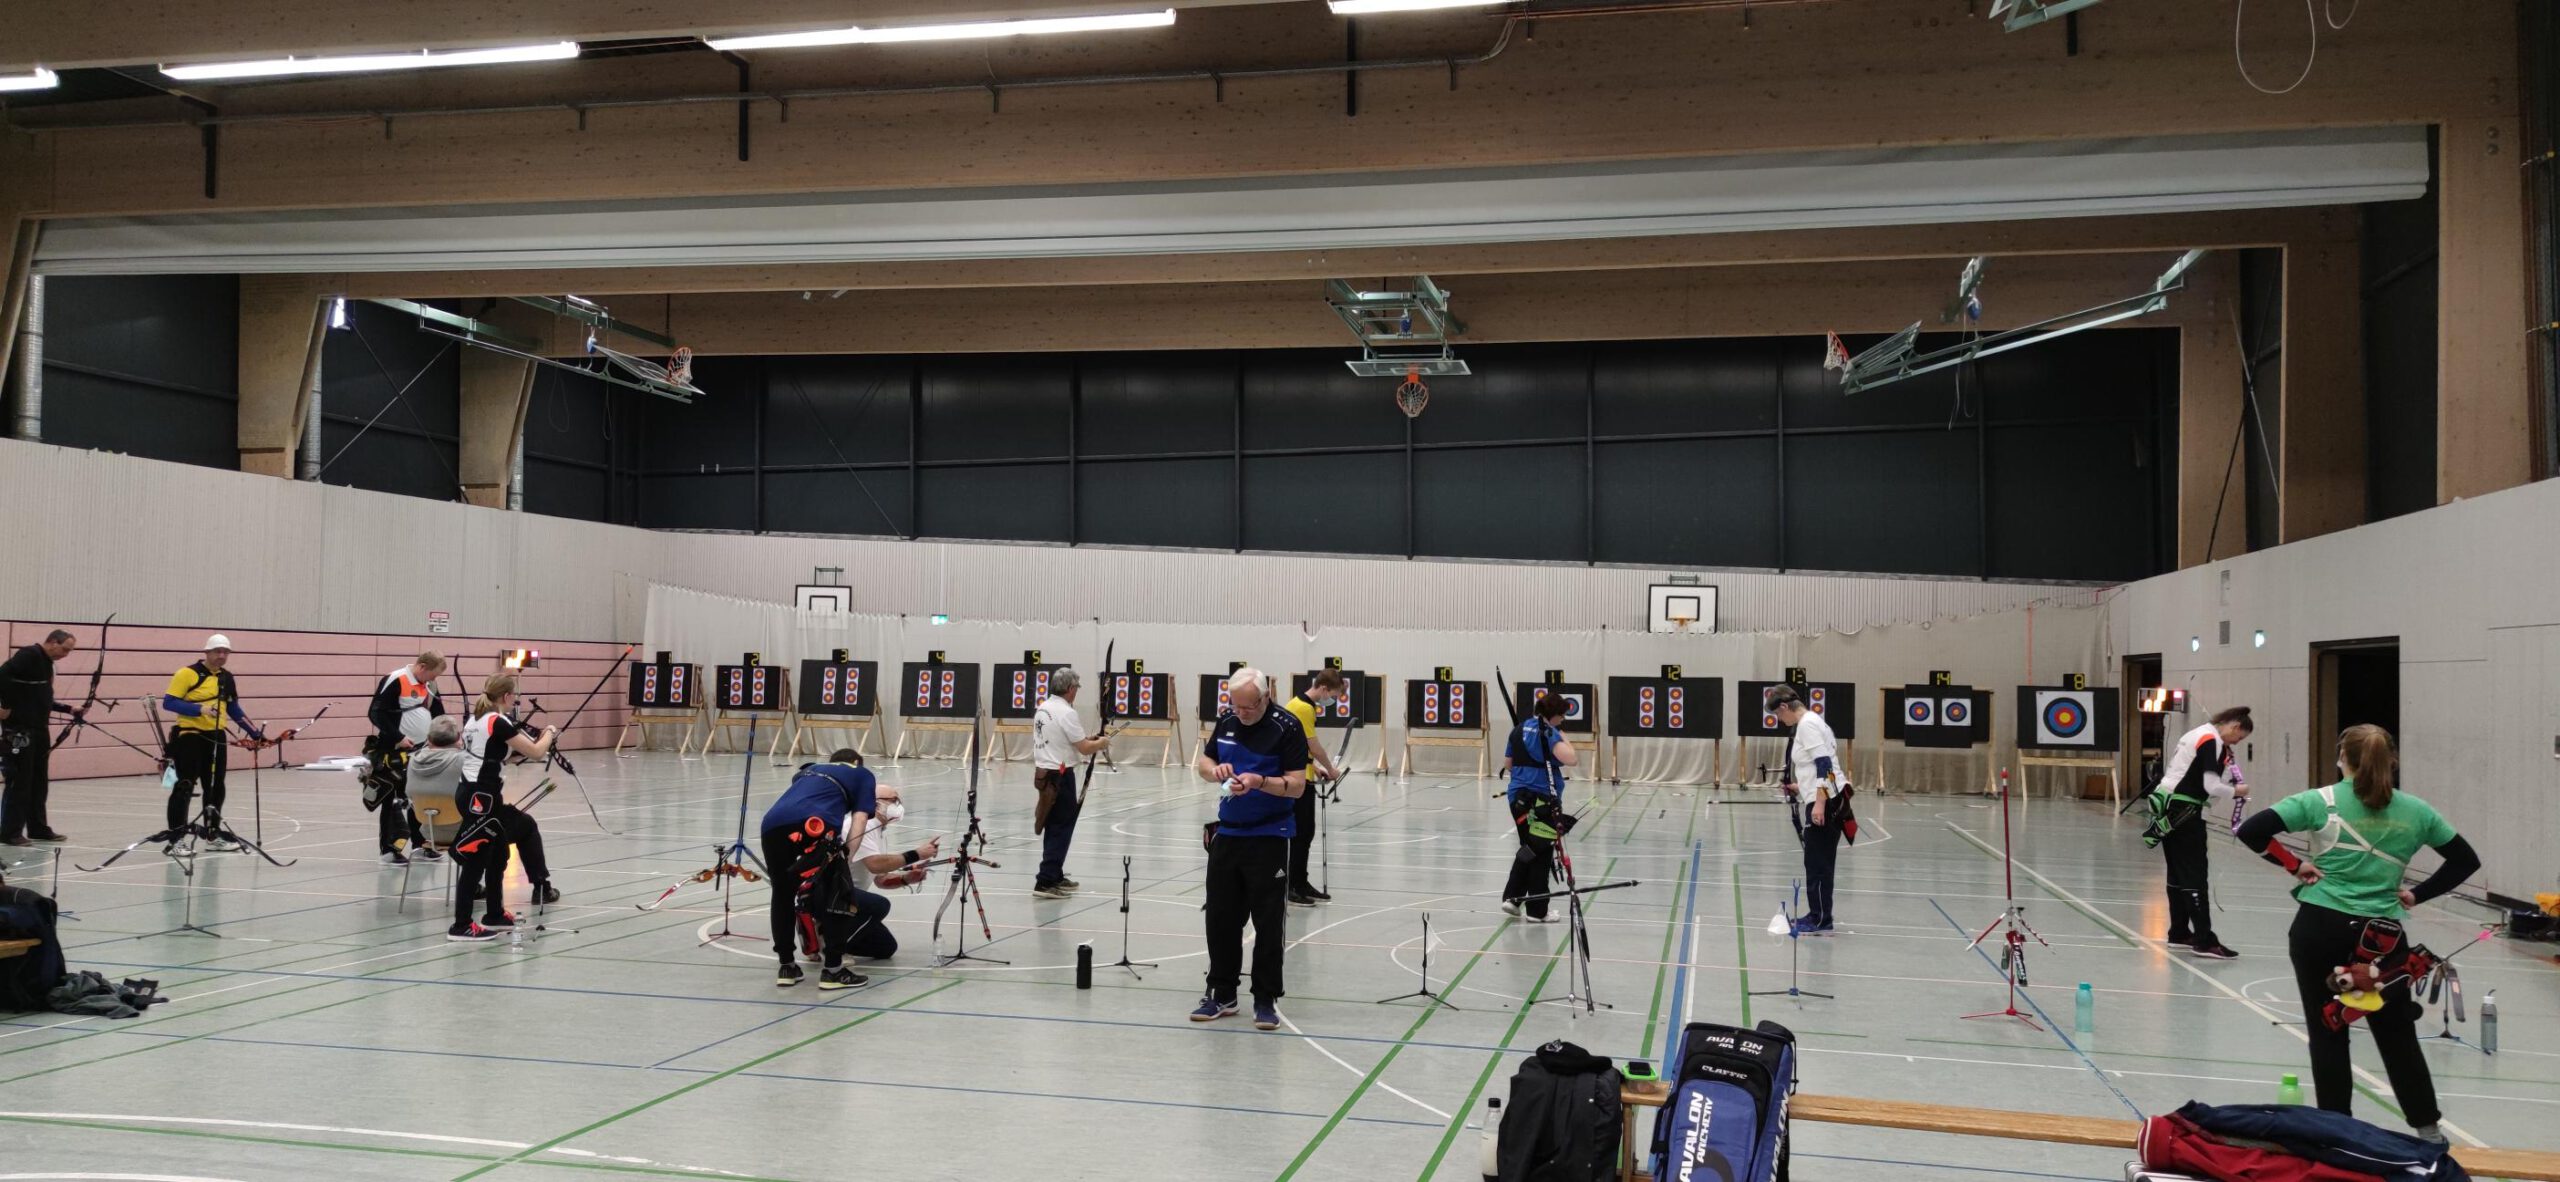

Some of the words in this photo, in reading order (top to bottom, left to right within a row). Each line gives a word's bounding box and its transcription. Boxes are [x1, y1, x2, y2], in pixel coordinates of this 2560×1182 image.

[750, 652, 760, 667] 2
[840, 648, 849, 663] 3
[935, 651, 945, 663] 4
[1031, 650, 1041, 665] 5
[1134, 659, 1143, 674] 6
[1332, 656, 1342, 672] 9
[1439, 666, 1453, 682] 10
[1550, 671, 1565, 684] 11
[1667, 665, 1681, 681] 12
[1936, 672, 1952, 687] 14
[2073, 672, 2087, 691] 8
[1706, 1036, 1763, 1050] AVAON
[1679, 1091, 1704, 1182] AVALON
[1696, 1096, 1713, 1163] ARCHERY
